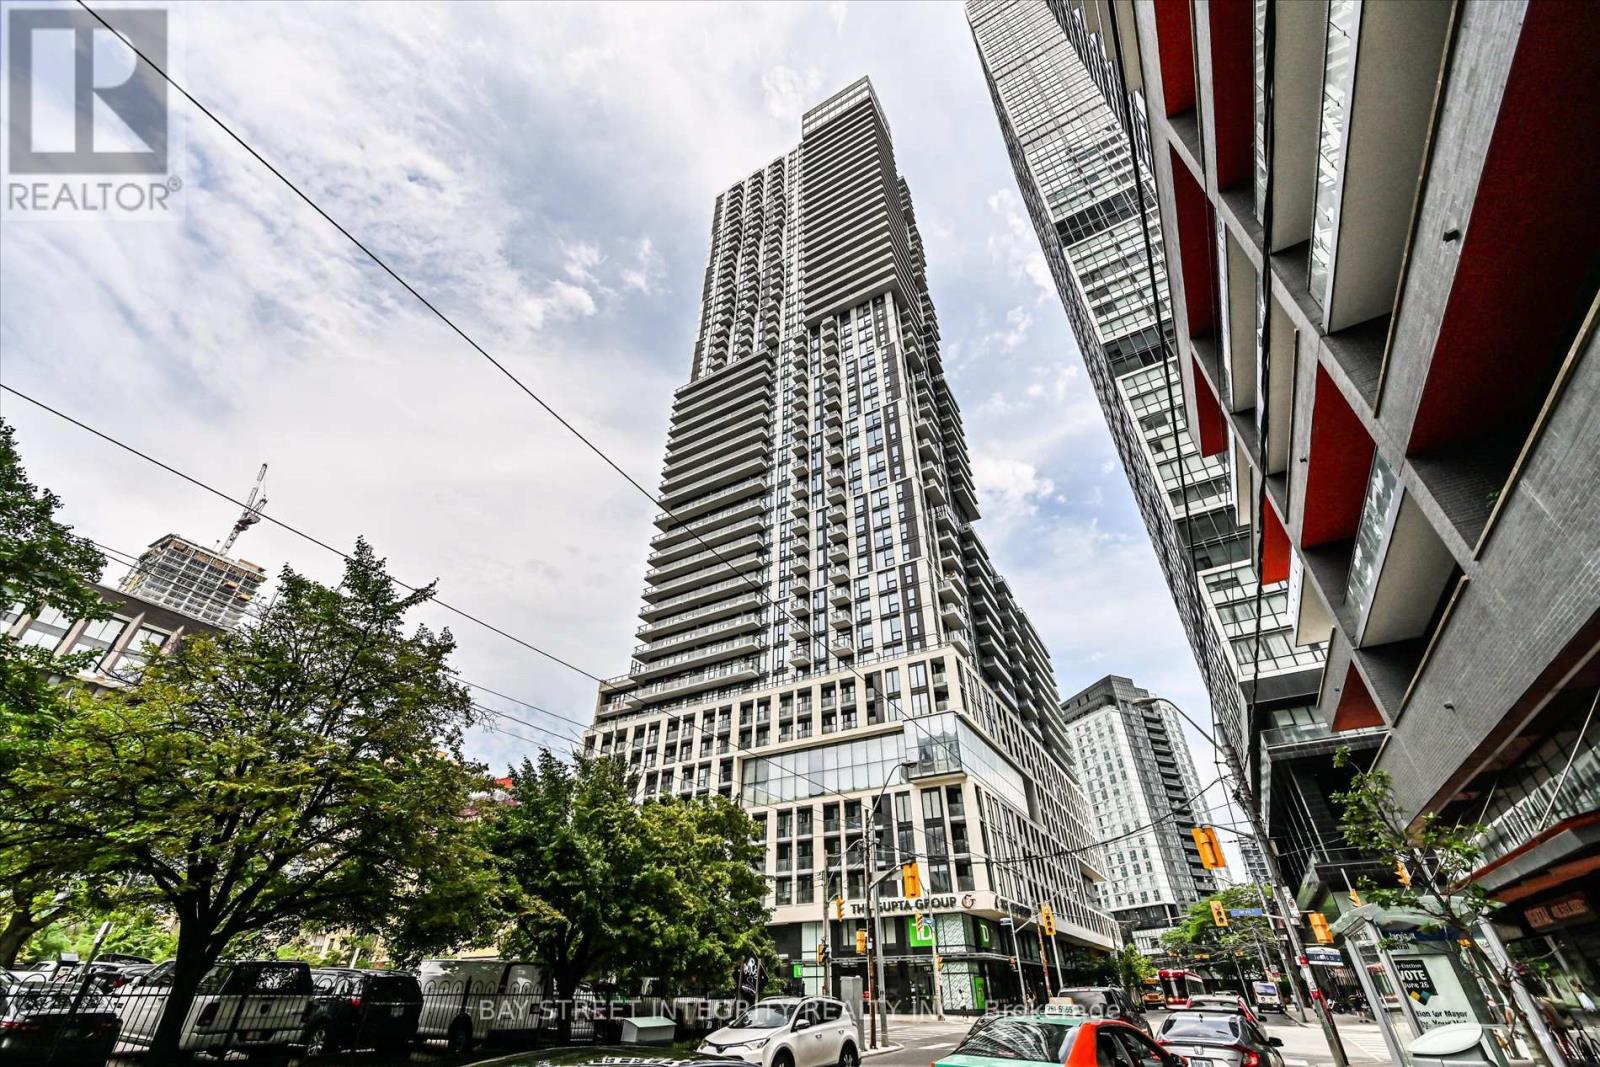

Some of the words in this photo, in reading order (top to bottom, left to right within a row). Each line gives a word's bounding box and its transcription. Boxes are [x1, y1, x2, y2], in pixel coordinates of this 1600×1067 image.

[878, 900, 912, 913] GUPTA
[915, 897, 957, 912] GROUP
[1400, 970, 1427, 980] VOTE
